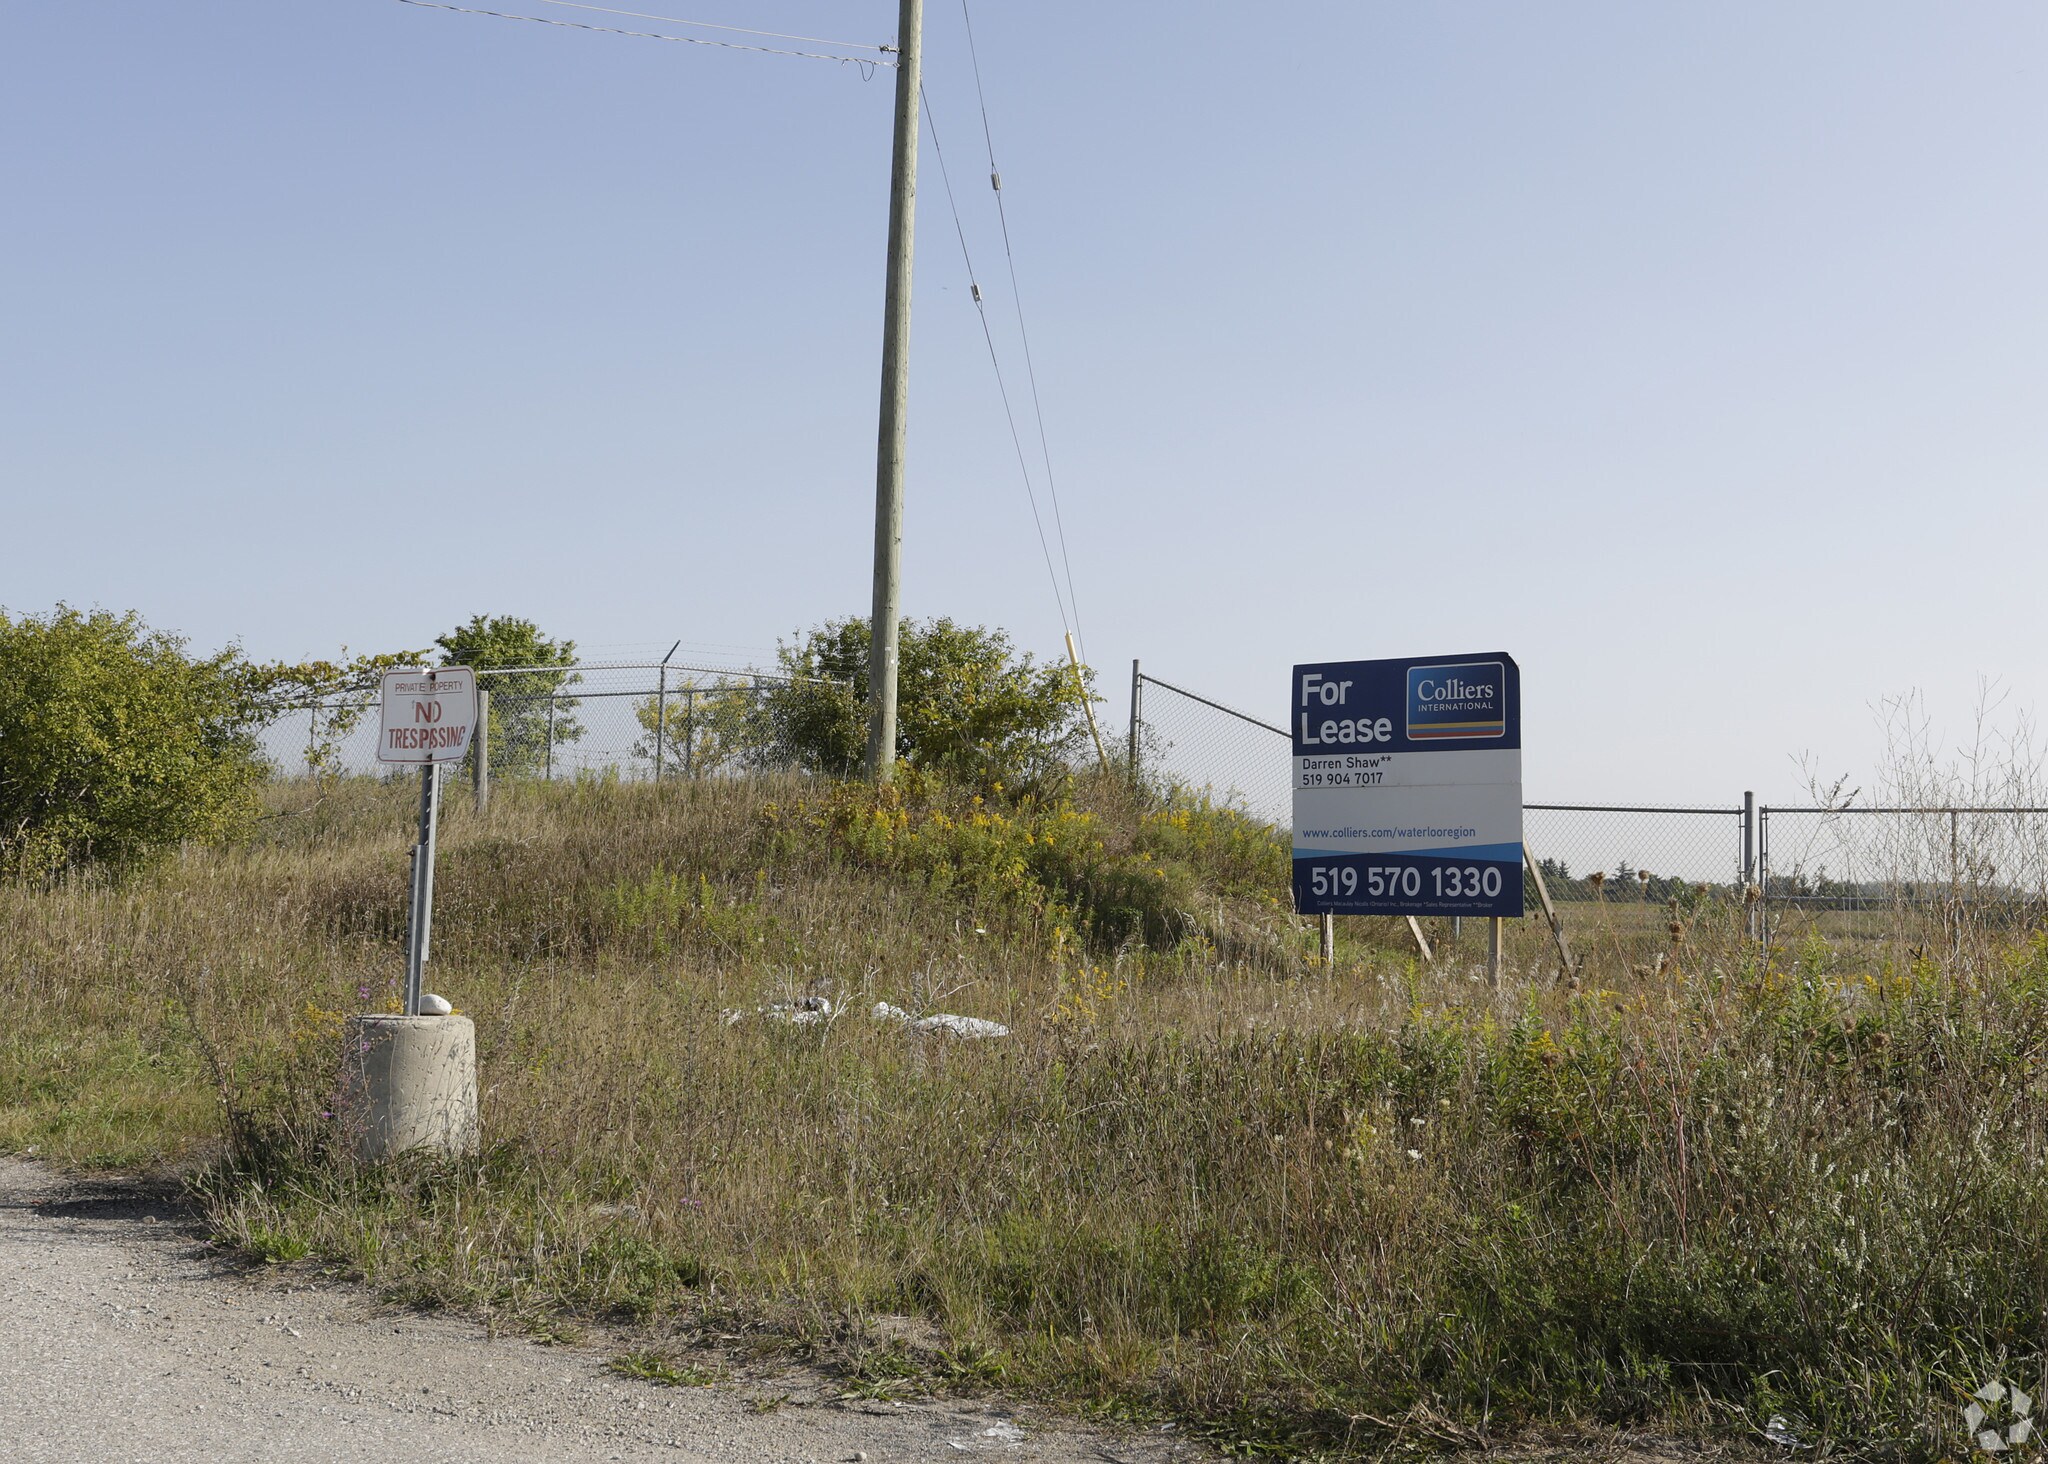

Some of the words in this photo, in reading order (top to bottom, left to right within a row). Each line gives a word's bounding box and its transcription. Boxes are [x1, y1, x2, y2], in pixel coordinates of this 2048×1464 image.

[395, 682, 426, 692] PRIVATE
[430, 681, 463, 692] POPERTY
[1302, 673, 1353, 706] For
[1417, 679, 1494, 701] Colliers
[1418, 702, 1493, 712] INTERNATIONAL
[1302, 712, 1393, 745] Lease
[1302, 758, 1342, 770] Darren
[1302, 774, 1323, 785] 519
[1326, 774, 1350, 785] 904
[1354, 773, 1383, 784] 7017
[1302, 826, 1476, 840] www.colliers.com/waterlooregion
[1311, 867, 1358, 896] 519
[1368, 867, 1421, 896] 570
[1431, 867, 1502, 897] 1330
